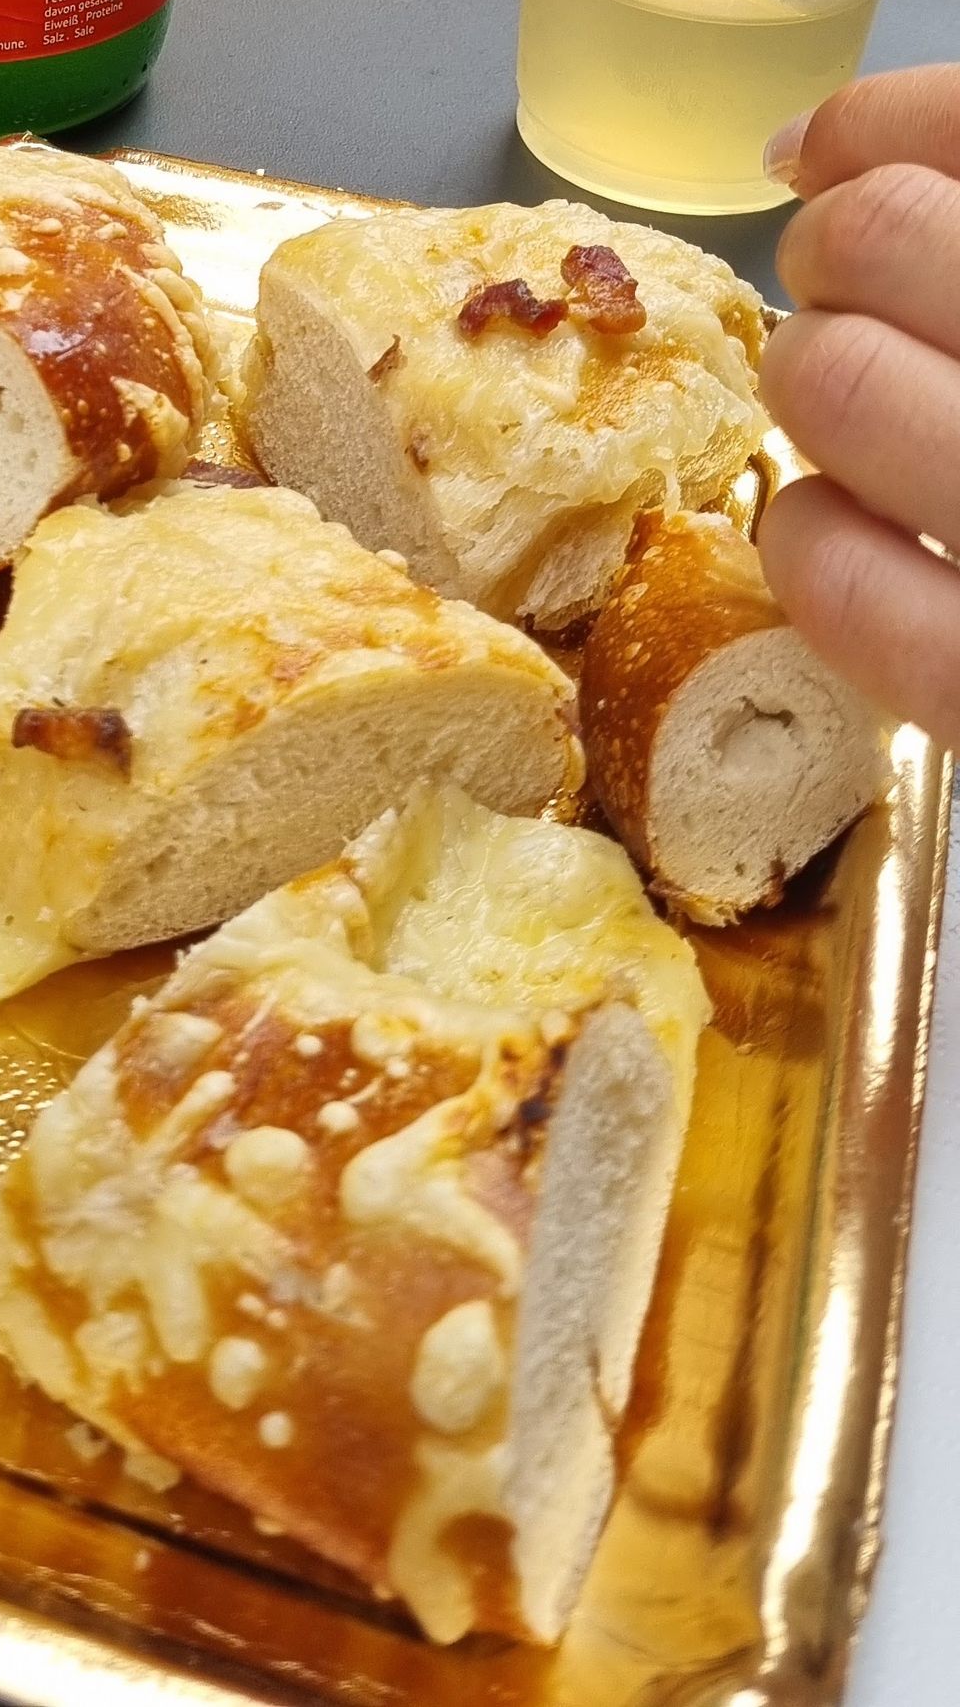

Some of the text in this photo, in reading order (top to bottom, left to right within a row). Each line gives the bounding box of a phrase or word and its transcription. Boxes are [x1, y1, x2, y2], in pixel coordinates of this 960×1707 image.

[44, 4, 76, 18] davon
[44, 14, 78, 31] Eiweiß
[86, 1, 123, 21] Proteine
[43, 33, 64, 45] Salz
[74, 25, 94, 38] Sale
